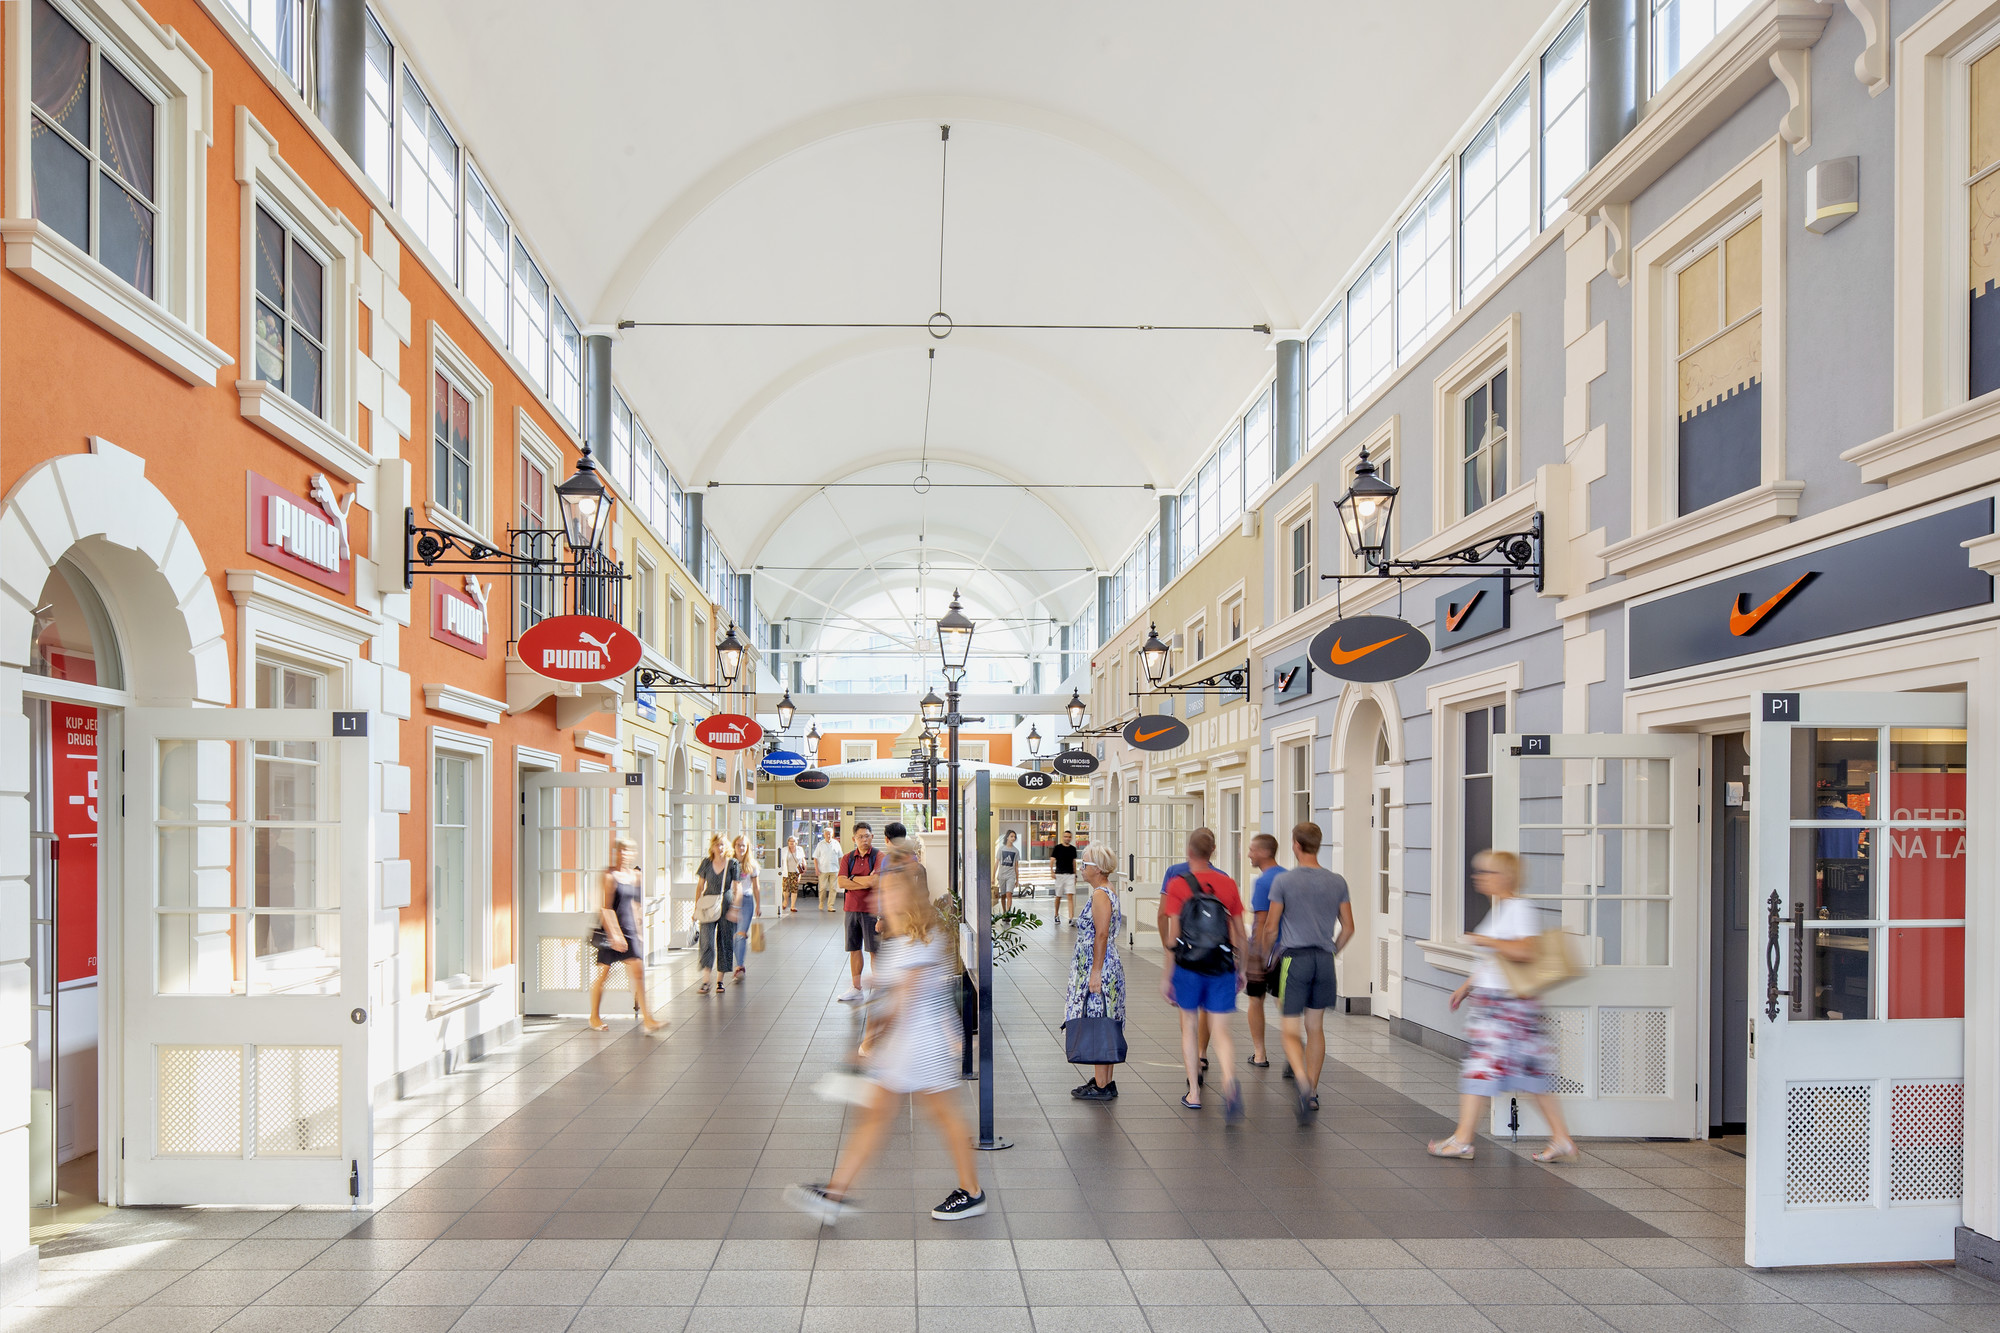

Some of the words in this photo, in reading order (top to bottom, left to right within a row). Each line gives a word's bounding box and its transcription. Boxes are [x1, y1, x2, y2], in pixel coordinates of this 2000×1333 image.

[268, 496, 340, 573] PUMA
[442, 594, 483, 645] PUMA
[543, 649, 600, 669] PUMA
[1772, 699, 1789, 714] P1
[66, 717, 83, 729] KUP
[342, 717, 356, 730] L1
[67, 733, 93, 746] DRUGI
[708, 732, 740, 743] PUMA
[1529, 739, 1542, 750] P1
[629, 775, 638, 783] L1
[1025, 775, 1043, 786] Lee
[1889, 835, 1927, 859] NA
